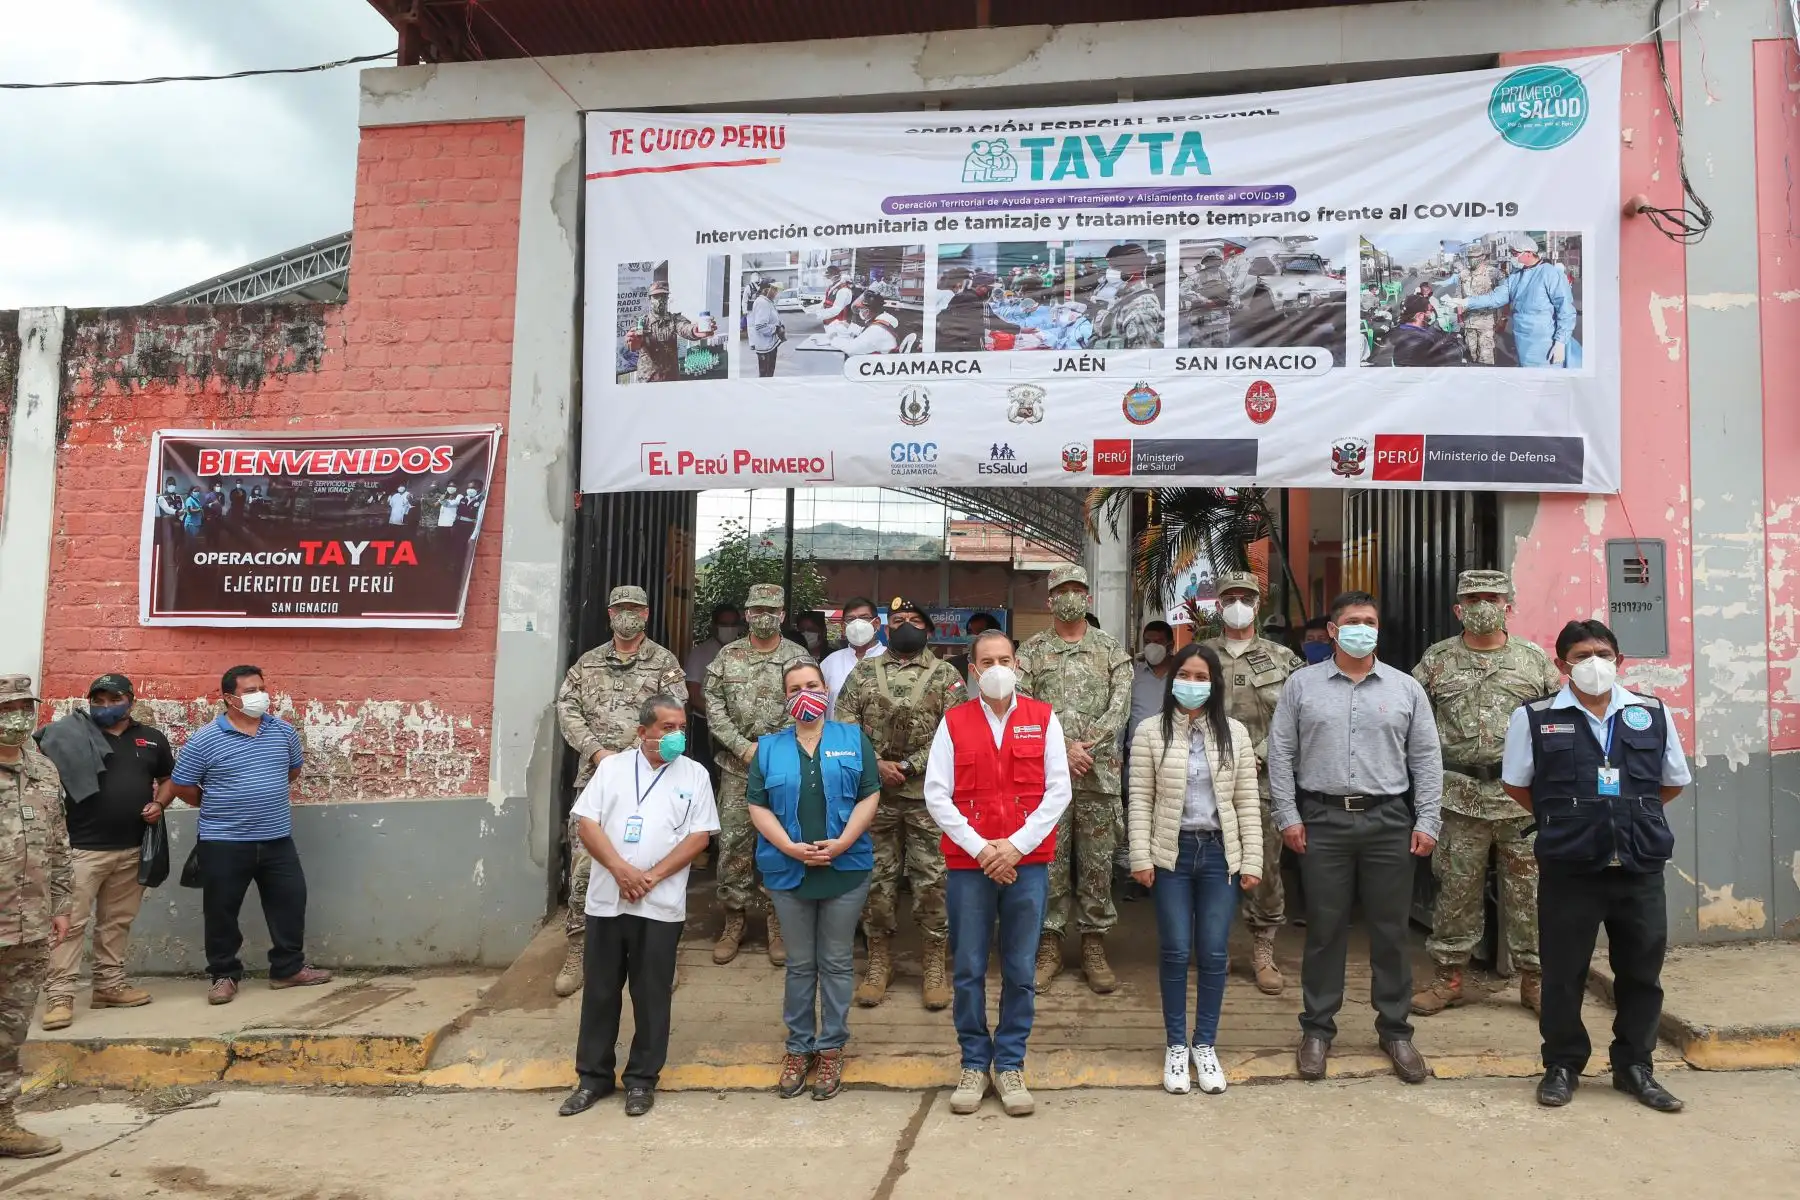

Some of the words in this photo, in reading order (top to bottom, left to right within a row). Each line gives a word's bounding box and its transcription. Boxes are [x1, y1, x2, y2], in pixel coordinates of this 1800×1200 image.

[1500, 84, 1562, 101] PRIMERO
[1501, 102, 1516, 114] MI
[1518, 97, 1581, 119] SALUD
[609, 129, 634, 156] TE
[640, 127, 716, 154] CUIDO
[1020, 131, 1212, 181] TAYTA
[891, 199, 938, 210] Operación
[940, 198, 985, 208] Territorial
[987, 197, 999, 206] de
[1002, 196, 1031, 207] Ayuda
[1034, 196, 1055, 205] para
[1057, 195, 1066, 204] el
[1068, 193, 1125, 203] Tratamiento
[1136, 192, 1193, 202] Aislamiento
[1195, 191, 1225, 201] frente
[1227, 191, 1237, 200] al
[1239, 191, 1286, 200] COVID-19
[695, 223, 808, 244] Intervención
[813, 217, 928, 237] comunitaria
[934, 215, 959, 231] de
[965, 212, 1051, 232] tamizaje
[1057, 214, 1070, 230] y
[1075, 210, 1200, 227] tratamiento
[1206, 208, 1311, 227] temprano
[1317, 205, 1383, 222] frente
[1388, 203, 1407, 220] al
[1413, 201, 1519, 219] COVID-19
[859, 359, 982, 376] CAJAMARCA
[1052, 354, 1106, 373] JAÉN
[1175, 356, 1218, 371] SAN
[1225, 354, 1317, 370] IGNACIO
[197, 446, 454, 477] BIENVENIDOS
[890, 442, 938, 462] GRC
[1097, 450, 1127, 463] PERÚ
[1136, 453, 1184, 462] Ministerio
[1377, 448, 1420, 464] PERÚ
[1428, 449, 1489, 462] Ministerio
[1491, 450, 1506, 462] de
[1509, 450, 1556, 463] Defensa
[891, 468, 938, 476] CAJAMARCA
[978, 462, 1028, 474] EsSalud
[1136, 462, 1149, 471] de
[1150, 462, 1176, 471] Salud
[193, 548, 302, 566] OPERACIÓN
[299, 540, 419, 566] TAYTA
[224, 570, 303, 593] EJÉRCITO
[310, 575, 341, 593] DEL
[348, 571, 394, 593] PERÚ
[271, 602, 291, 613] SAN
[295, 602, 339, 613] IGNACIO
